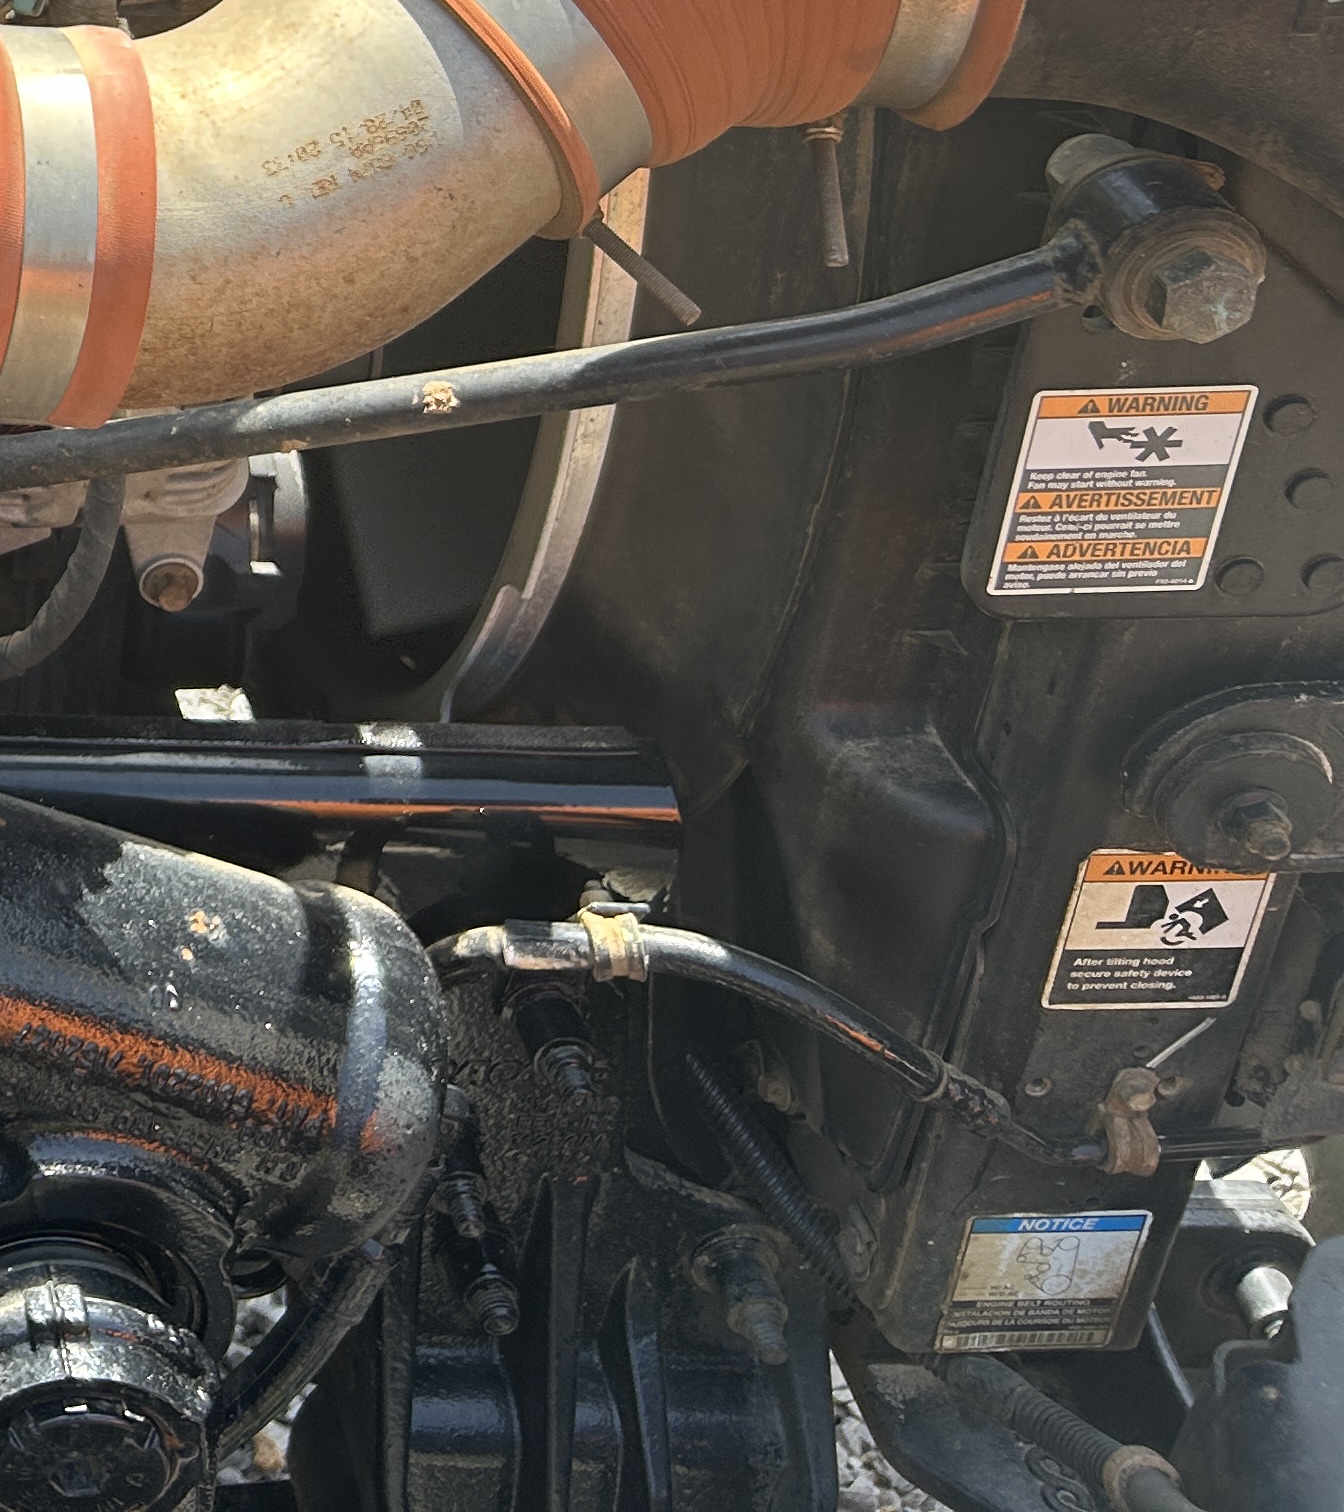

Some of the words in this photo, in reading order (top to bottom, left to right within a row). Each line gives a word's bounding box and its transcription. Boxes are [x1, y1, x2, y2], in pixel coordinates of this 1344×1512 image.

[1107, 396, 1209, 413] WARNING
[1030, 472, 1054, 481] Keep
[1057, 472, 1080, 480] clear
[1083, 471, 1094, 479] of
[1095, 470, 1128, 482] engine
[1130, 470, 1147, 478] fan.
[1027, 481, 1046, 489] Fan
[1048, 480, 1069, 490] may
[1071, 480, 1094, 488] start
[1096, 478, 1134, 488] without
[1135, 478, 1177, 488] warning.
[1048, 490, 1218, 510] AVERTISSEMENT
[1096, 513, 1108, 521] du
[1163, 511, 1177, 519] du
[1148, 521, 1181, 529] mettre
[1045, 540, 1192, 559] ADVERTENCIA
[1104, 561, 1120, 570] del
[1170, 559, 1187, 568] del
[1111, 570, 1127, 578] sin
[1073, 957, 1104, 967] After
[1106, 957, 1141, 967] tilting
[1143, 957, 1175, 965] hood
[1070, 970, 1112, 978] secure
[1114, 969, 1149, 979] safety
[1154, 969, 1193, 977] device
[1067, 982, 1079, 990] to
[1081, 982, 1127, 991] prevent
[1130, 981, 1176, 990] closing.
[1017, 1218, 1100, 1231] NOTICE
[1077, 1307, 1110, 1315] MOTOR
[991, 1318, 1003, 1326] DE
[1017, 1317, 1060, 1325] COURROIE
